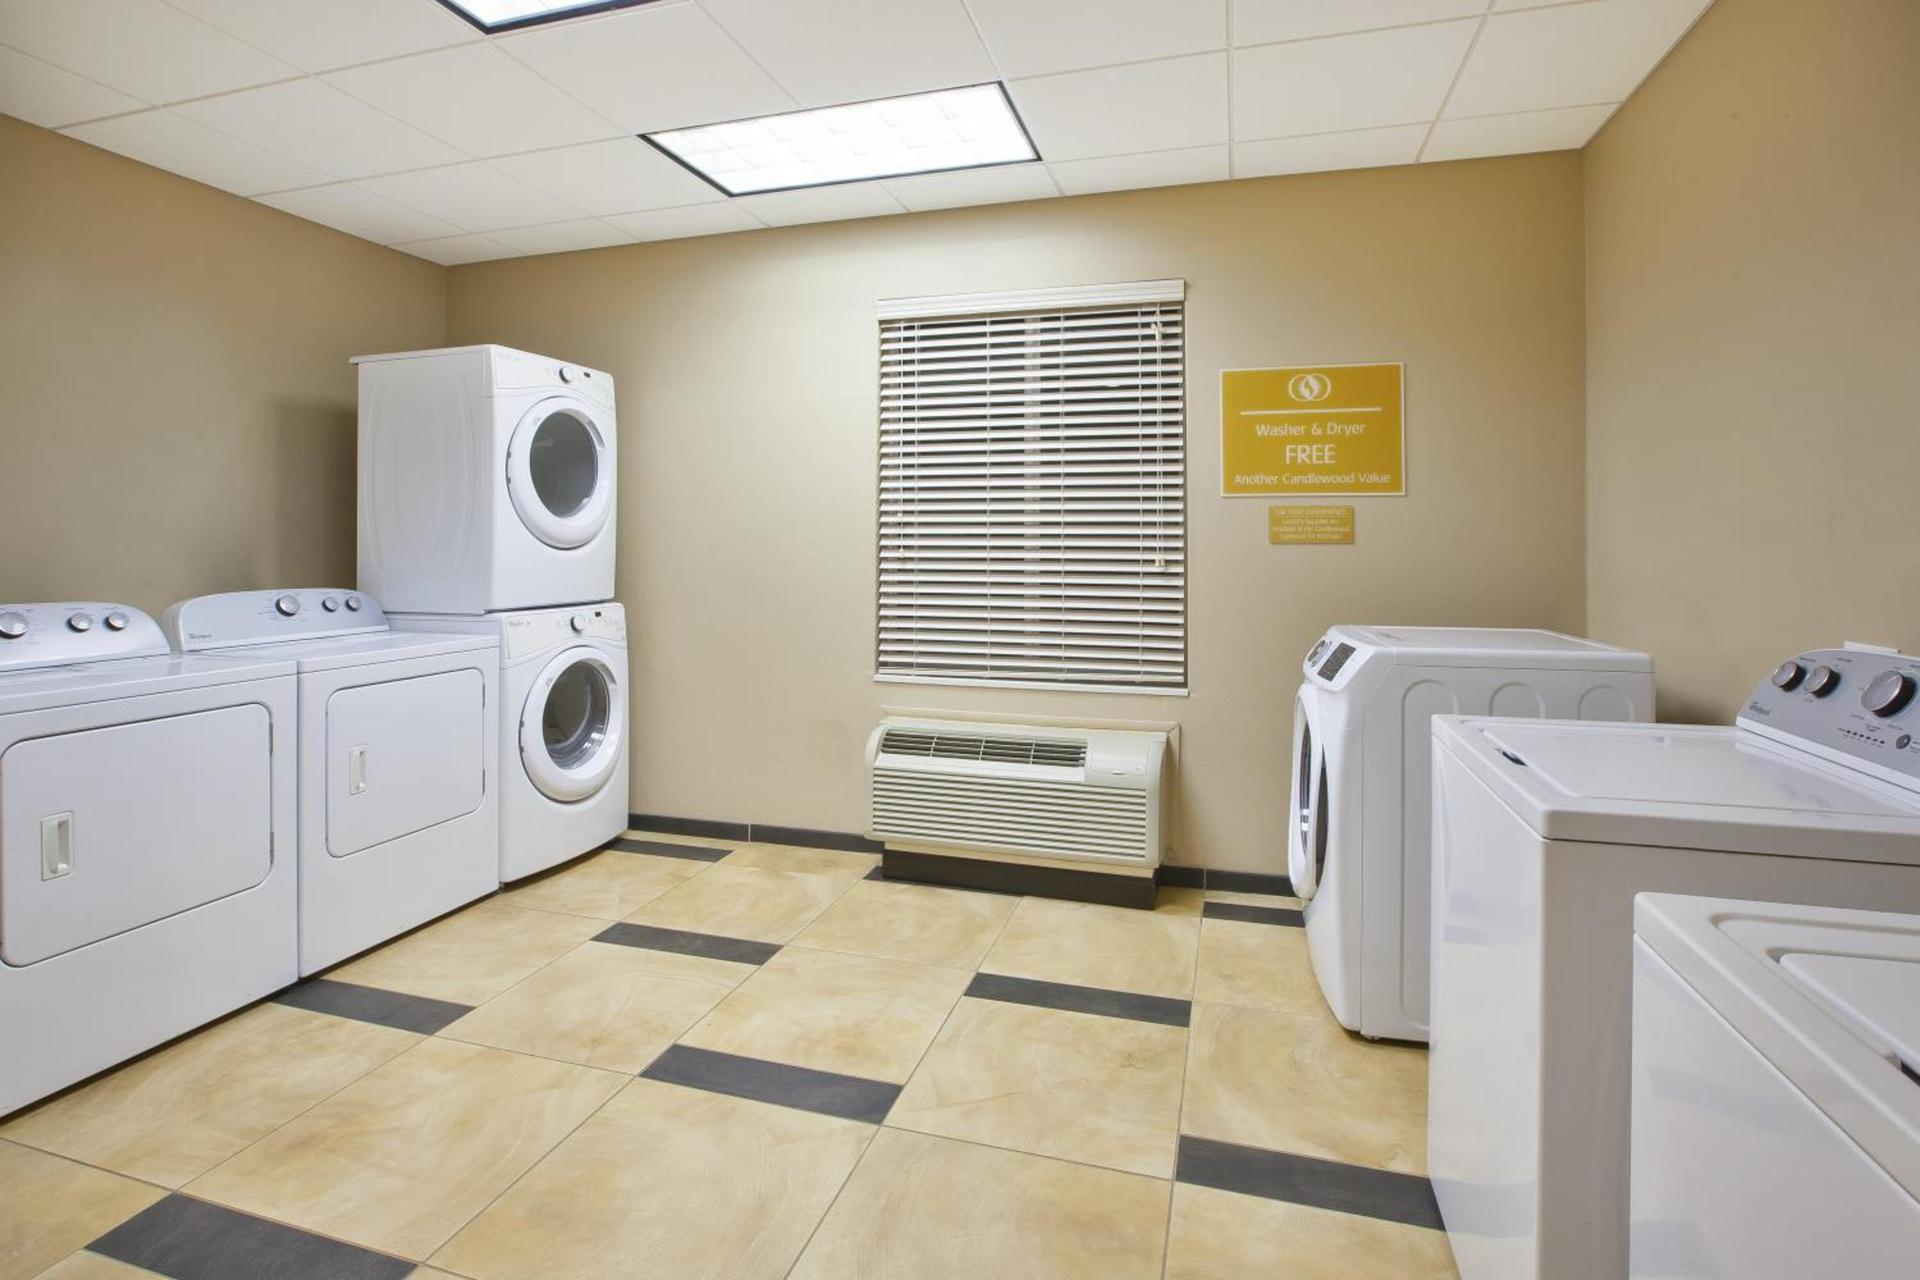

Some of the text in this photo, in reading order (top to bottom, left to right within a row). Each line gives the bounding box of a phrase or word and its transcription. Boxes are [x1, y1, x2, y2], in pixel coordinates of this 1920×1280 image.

[1256, 421, 1366, 436] Washer & Dryer
[1285, 444, 1336, 464] FREE
[1234, 471, 1391, 485] Another Candlewood Value
